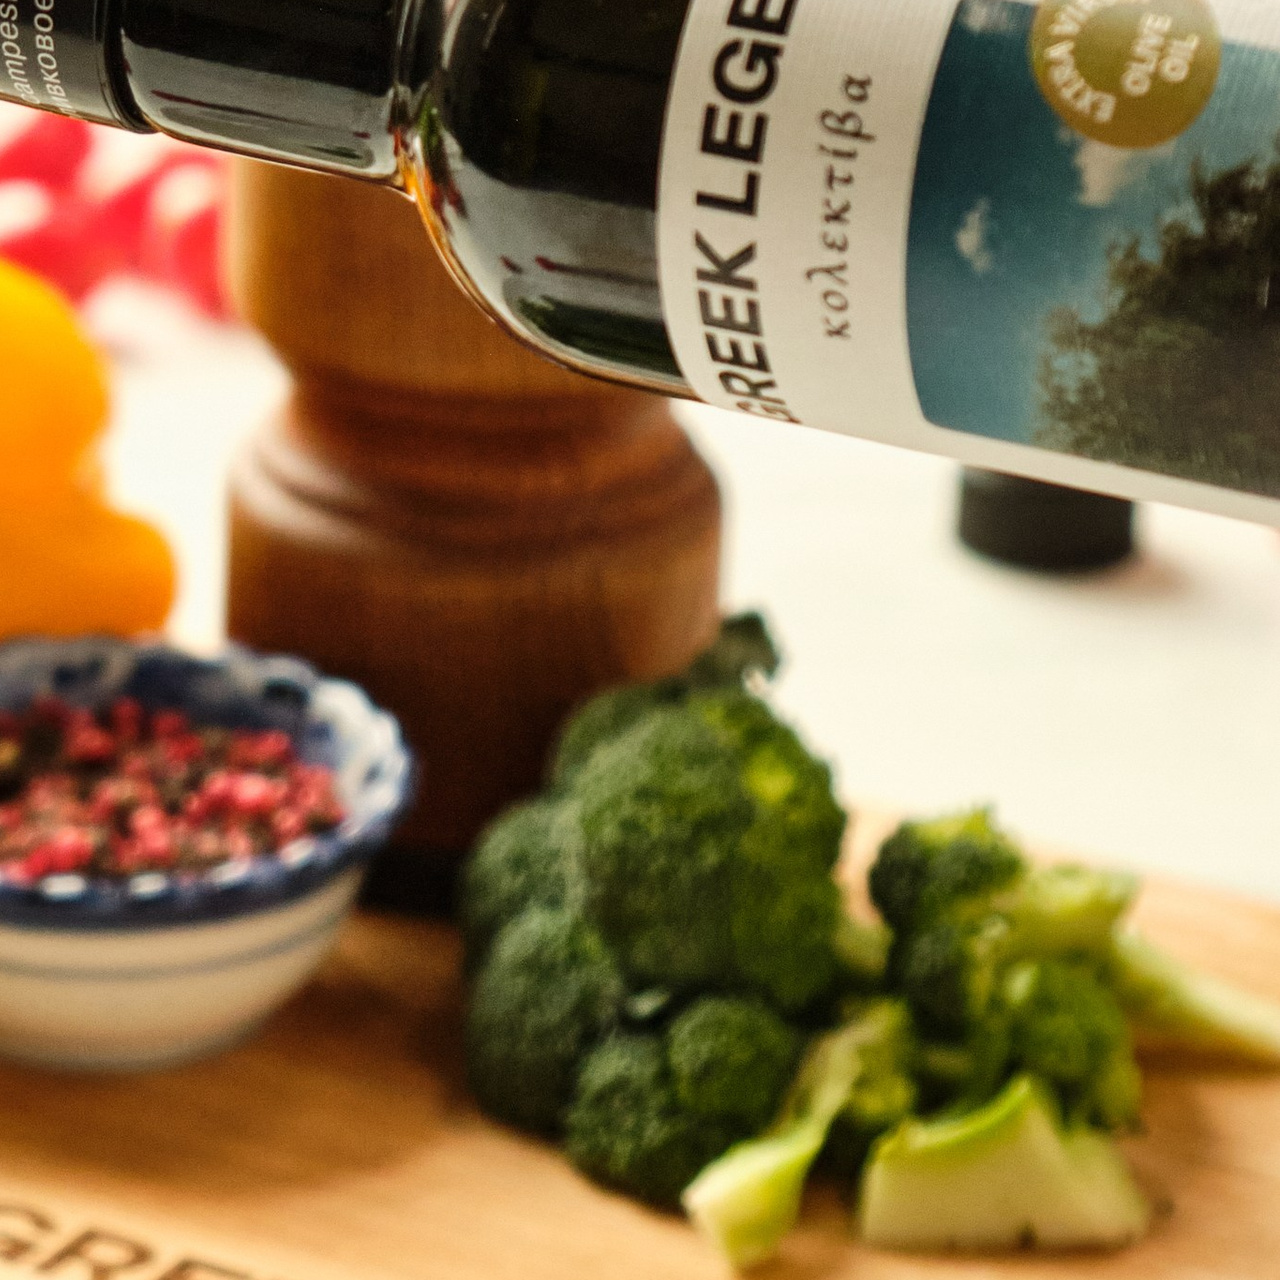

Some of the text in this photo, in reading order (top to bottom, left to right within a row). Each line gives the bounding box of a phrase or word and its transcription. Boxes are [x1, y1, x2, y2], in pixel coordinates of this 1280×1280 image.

[1044, 40, 1117, 124] EXTRA
[1120, 12, 1174, 97] OLIVE
[1157, 33, 1199, 83] OIL
[806, 73, 874, 340] κολεκτίβα
[695, 230, 803, 423] GREEK
